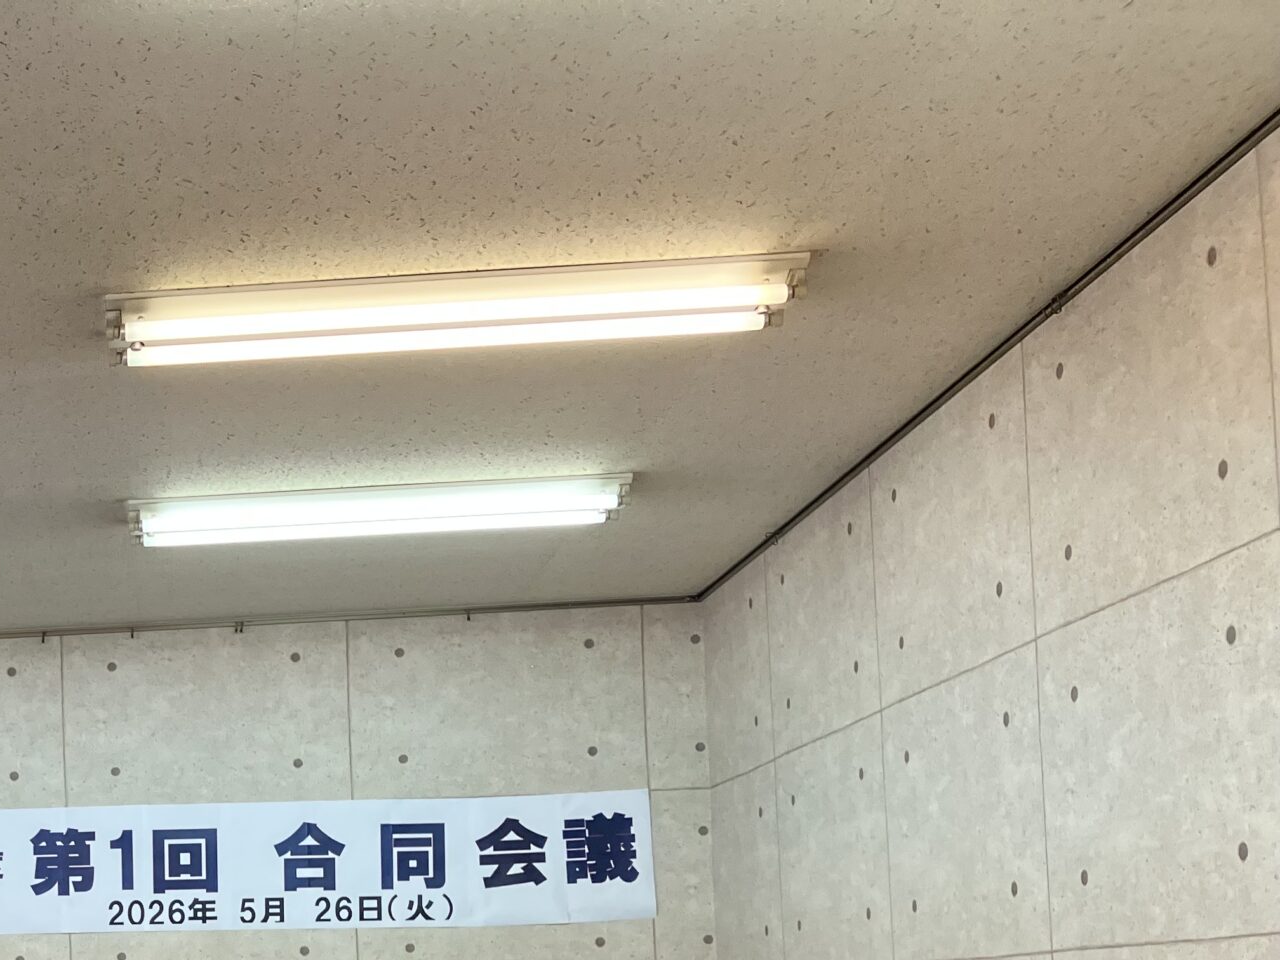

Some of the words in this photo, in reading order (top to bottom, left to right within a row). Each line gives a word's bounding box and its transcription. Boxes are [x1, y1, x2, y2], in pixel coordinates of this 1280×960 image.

[29, 827, 219, 896] 第1回
[273, 811, 640, 892] 合同会議
[108, 897, 218, 926] 2026年
[239, 897, 286, 924] 5月
